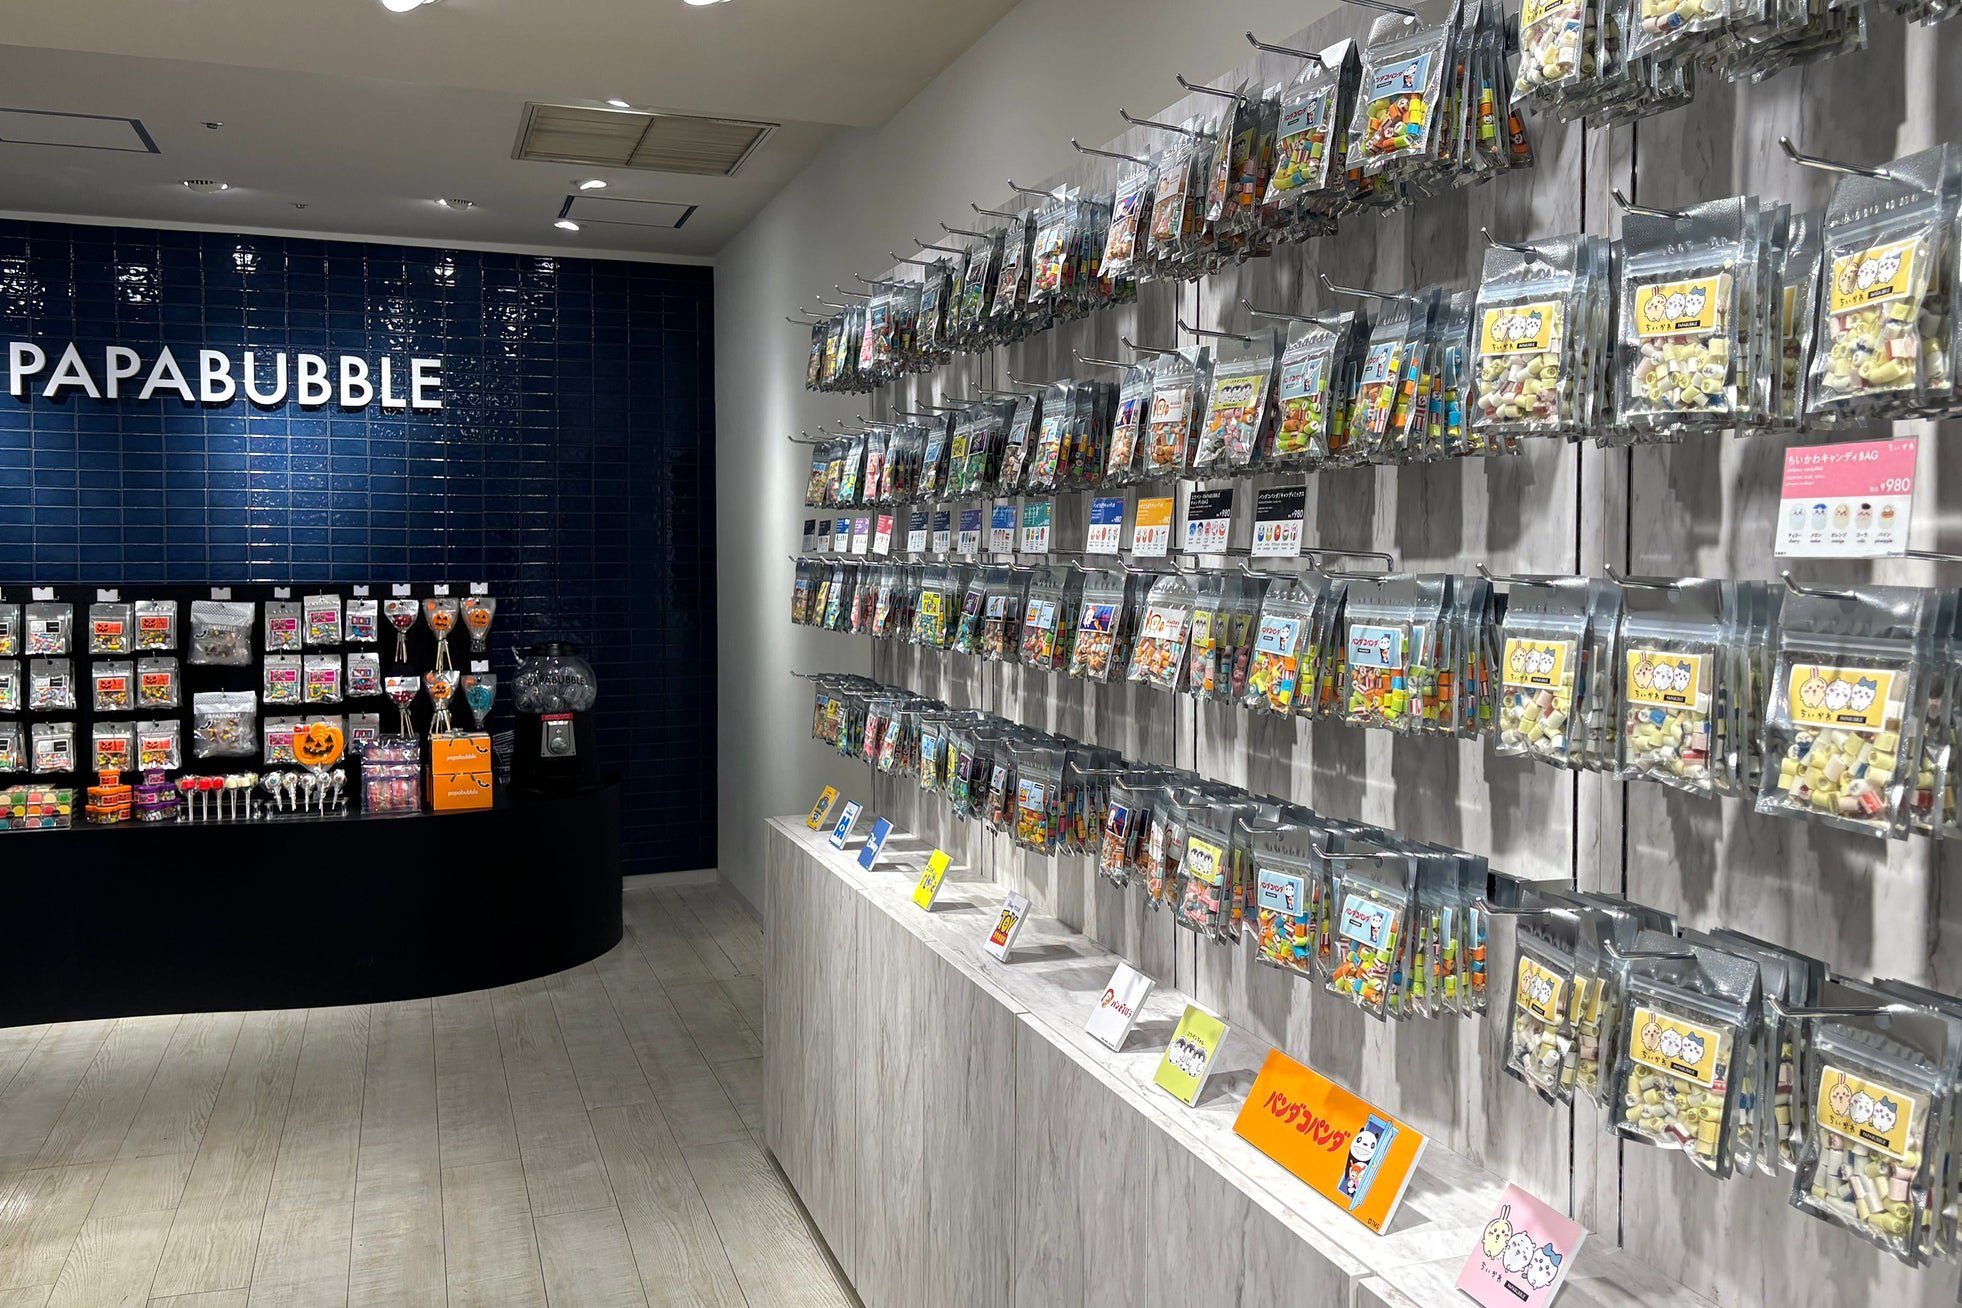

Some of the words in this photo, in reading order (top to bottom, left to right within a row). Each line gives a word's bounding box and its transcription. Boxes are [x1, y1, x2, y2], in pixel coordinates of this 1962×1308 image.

[9, 341, 442, 408] PAPABUBBLE
[1788, 450, 1879, 465] ちいかわキャンディBAG
[1263, 1091, 1351, 1152] パンダコパンダ
